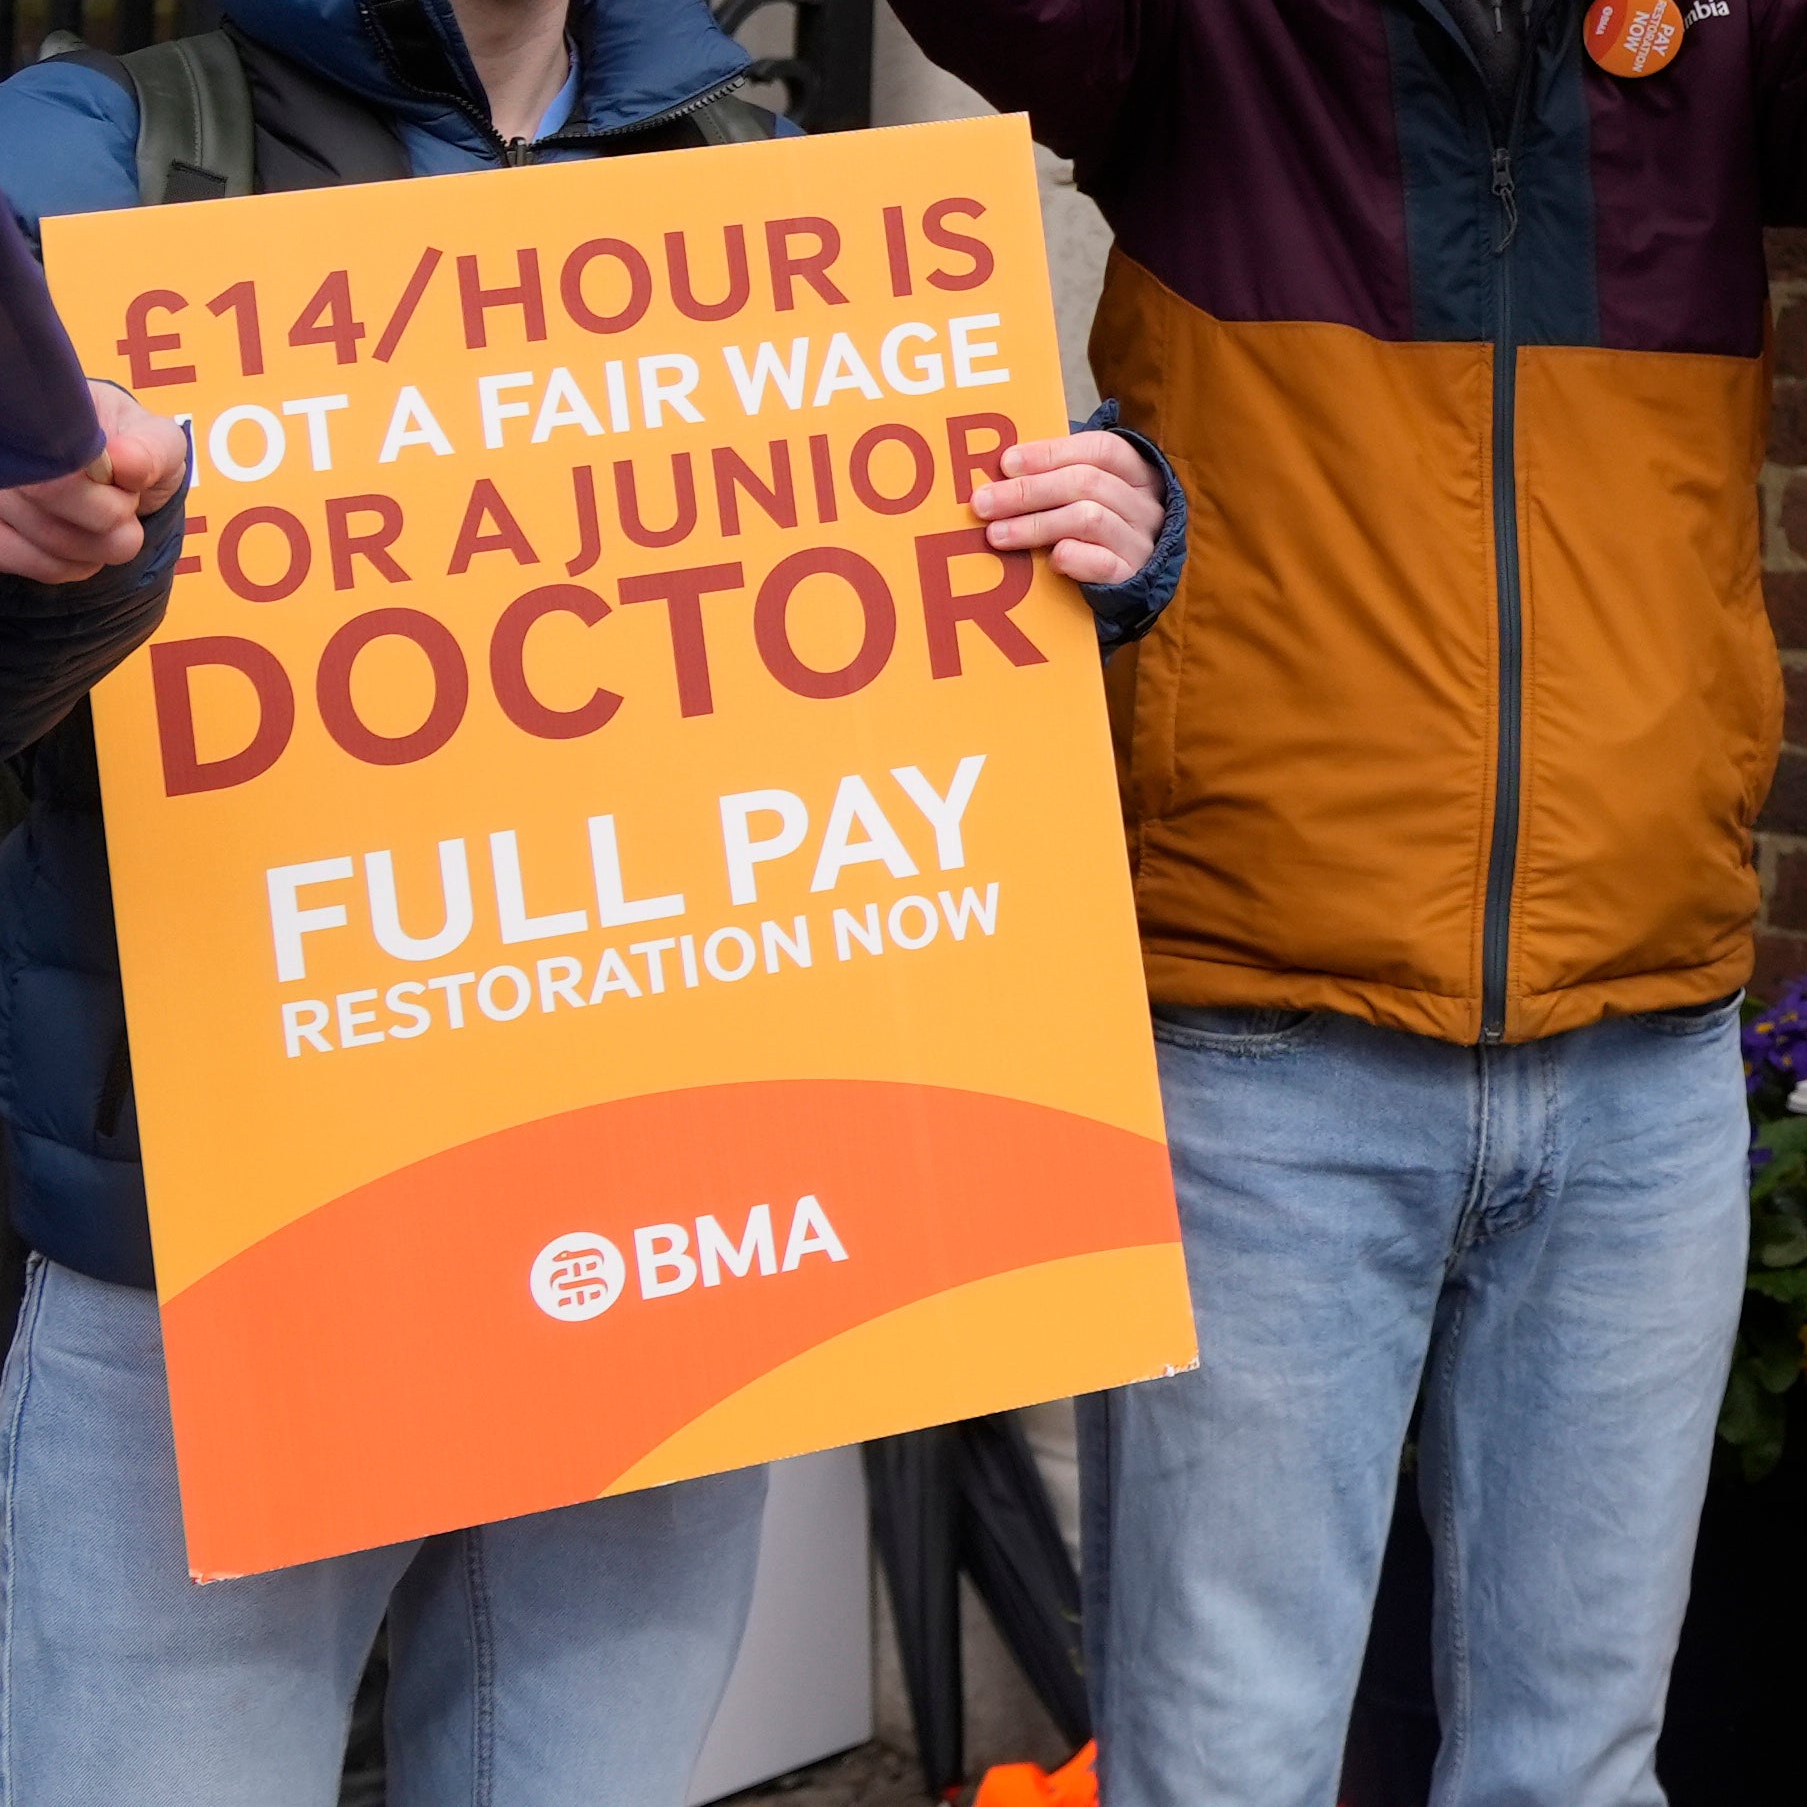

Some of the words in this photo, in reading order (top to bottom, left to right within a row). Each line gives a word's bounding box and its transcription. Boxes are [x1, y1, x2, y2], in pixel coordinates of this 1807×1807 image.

[1623, 10, 1651, 53] NOW
[1632, 0, 1668, 73] RESTORATION
[1652, 23, 1675, 57] PAY
[116, 213, 848, 391] £14/HOUR
[883, 195, 997, 300] IS
[380, 381, 455, 465] A
[481, 351, 704, 454] FAIR
[723, 312, 1011, 415] WAGE
[446, 480, 539, 577] A
[565, 412, 1019, 579] JUNIOR
[149, 527, 1050, 797] DOCTOR
[267, 813, 684, 984] FULL
[719, 755, 987, 905] PAY
[280, 904, 815, 1059] RESTORATION
[833, 883, 1001, 963] NOW
[634, 1194, 849, 1304] BMA
